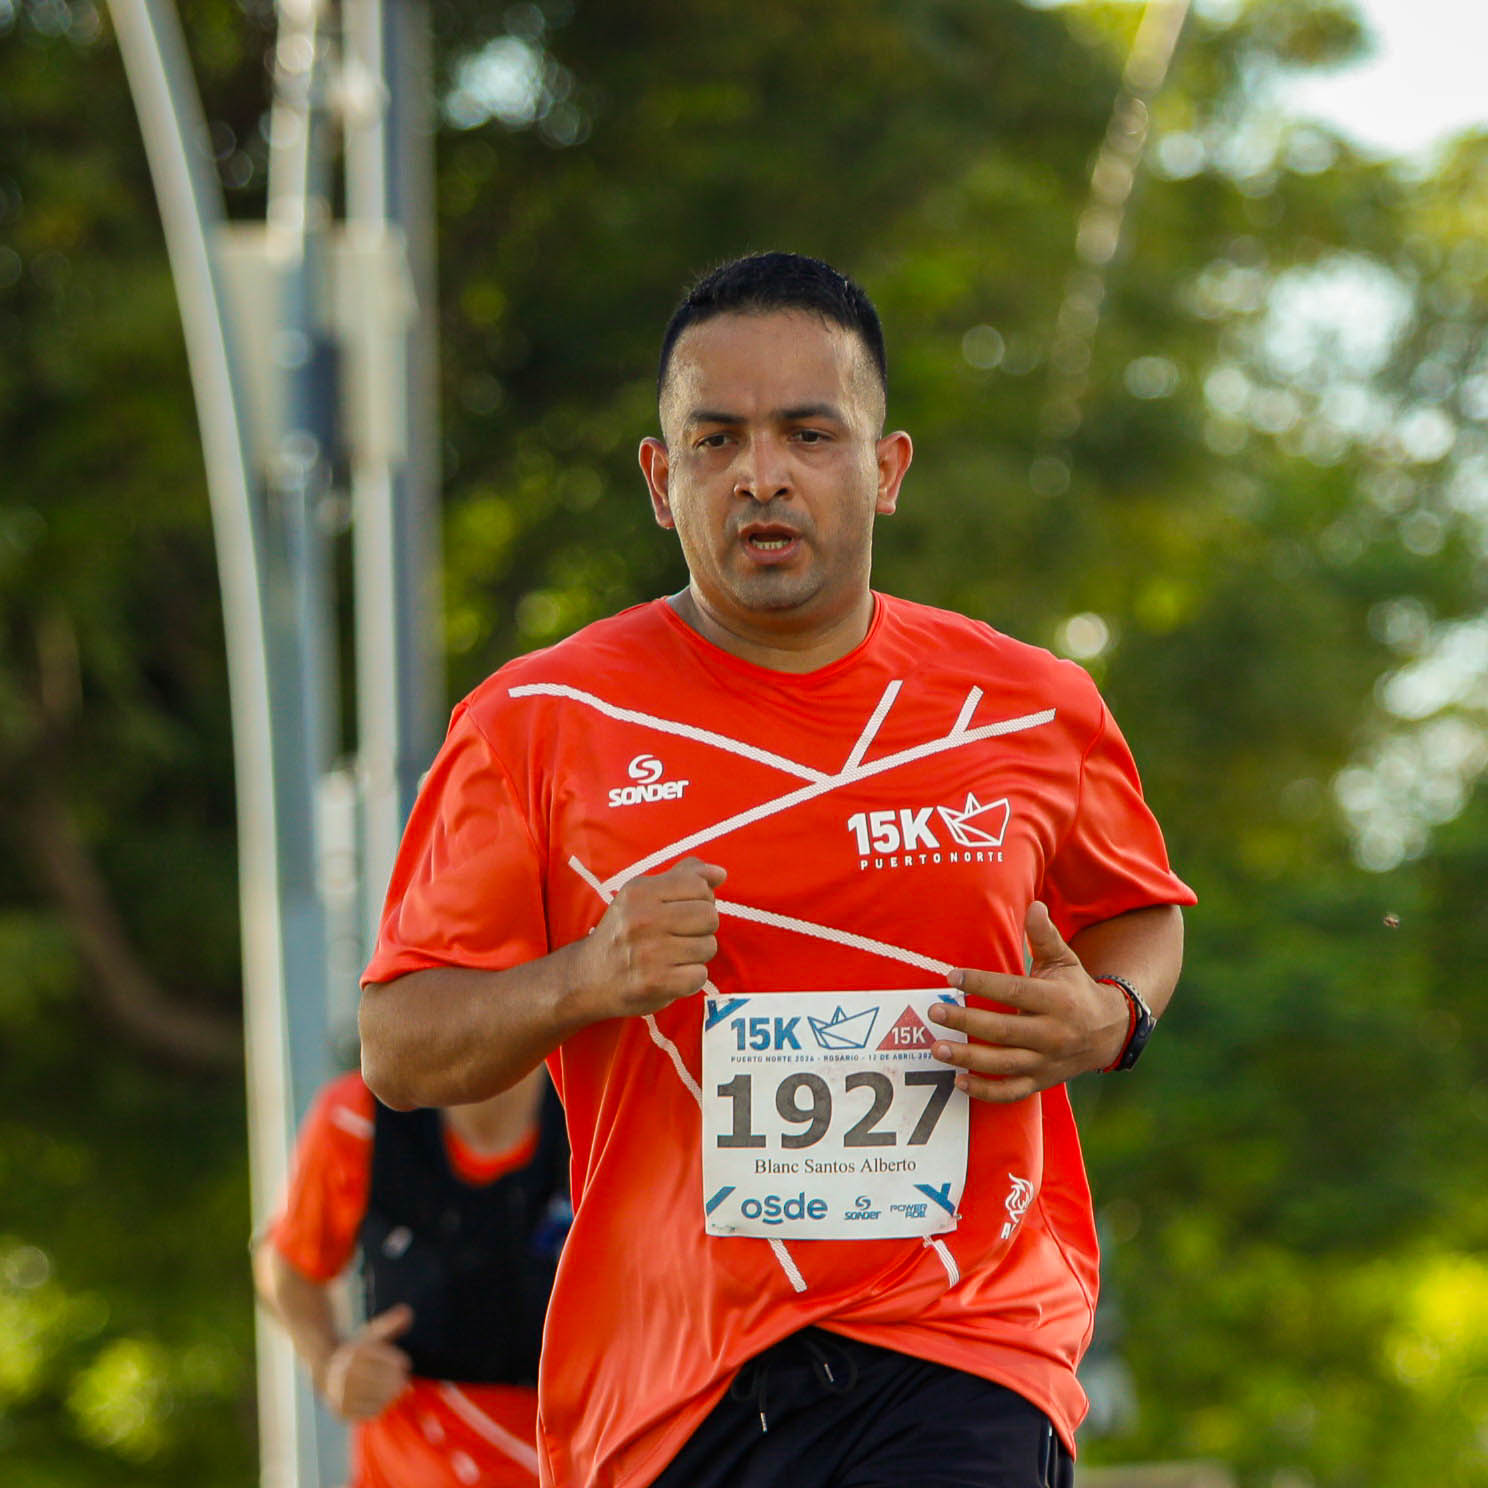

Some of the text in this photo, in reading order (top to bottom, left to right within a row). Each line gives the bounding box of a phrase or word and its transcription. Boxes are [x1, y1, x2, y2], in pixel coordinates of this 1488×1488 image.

[847, 806, 941, 856] 15K
[860, 851, 1004, 870] PUERTO NORTE
[730, 1016, 803, 1051] 15K
[891, 1025, 928, 1045] 15K
[730, 1055, 763, 1063] PUERTO
[765, 1055, 791, 1063] NORTE
[823, 1054, 858, 1062] ROSARIO
[879, 1053, 889, 1061] DE
[892, 1052, 916, 1061] ABRIL
[918, 1052, 932, 1060] 202
[716, 1069, 957, 1149] 1927
[754, 1157, 917, 1174] Blanc Santos Alberto
[741, 1192, 829, 1222] osde
[890, 1203, 928, 1212] POWER
